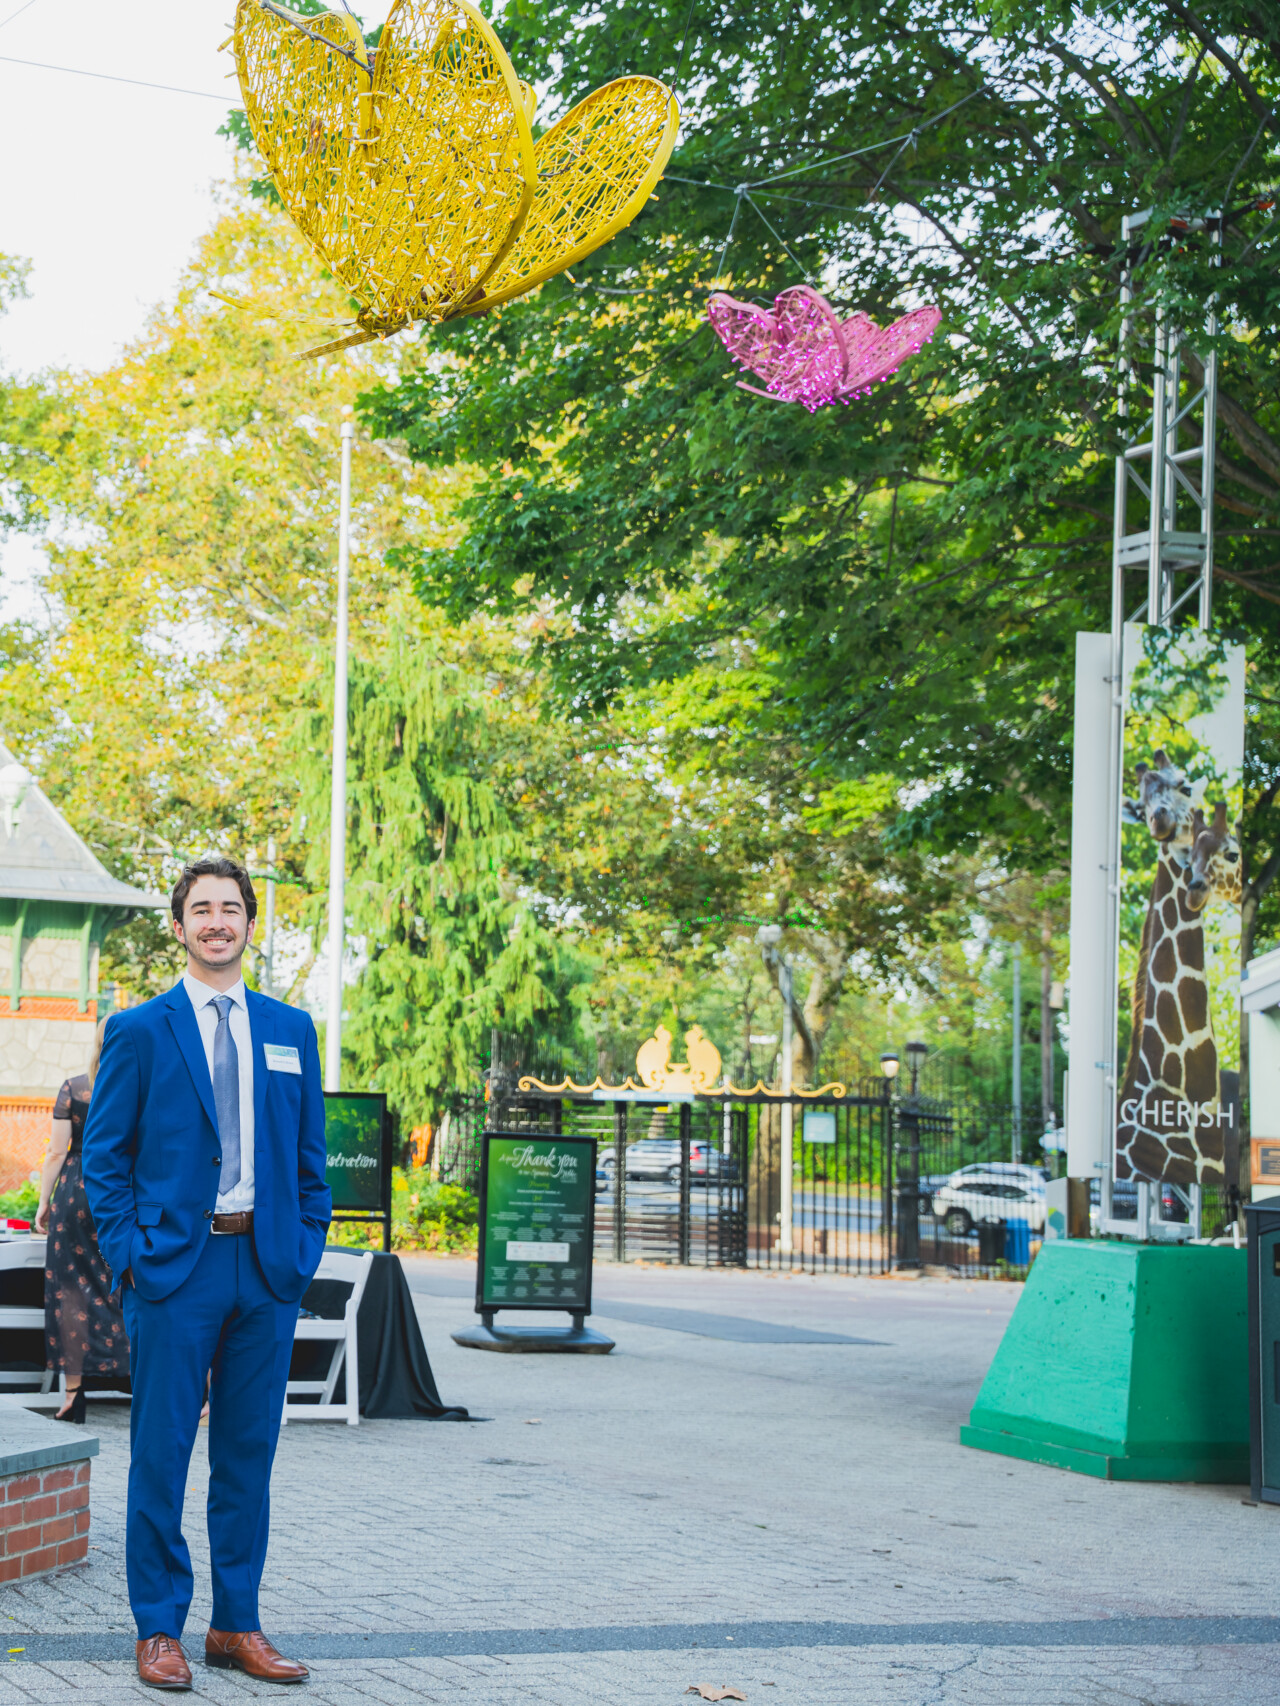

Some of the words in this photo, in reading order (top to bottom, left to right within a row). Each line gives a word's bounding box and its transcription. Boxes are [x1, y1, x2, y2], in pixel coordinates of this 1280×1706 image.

[1119, 1099, 1234, 1128] CHERISH
[326, 1152, 377, 1168] istration
[512, 1144, 556, 1168] Thank
[551, 1154, 578, 1178] you
